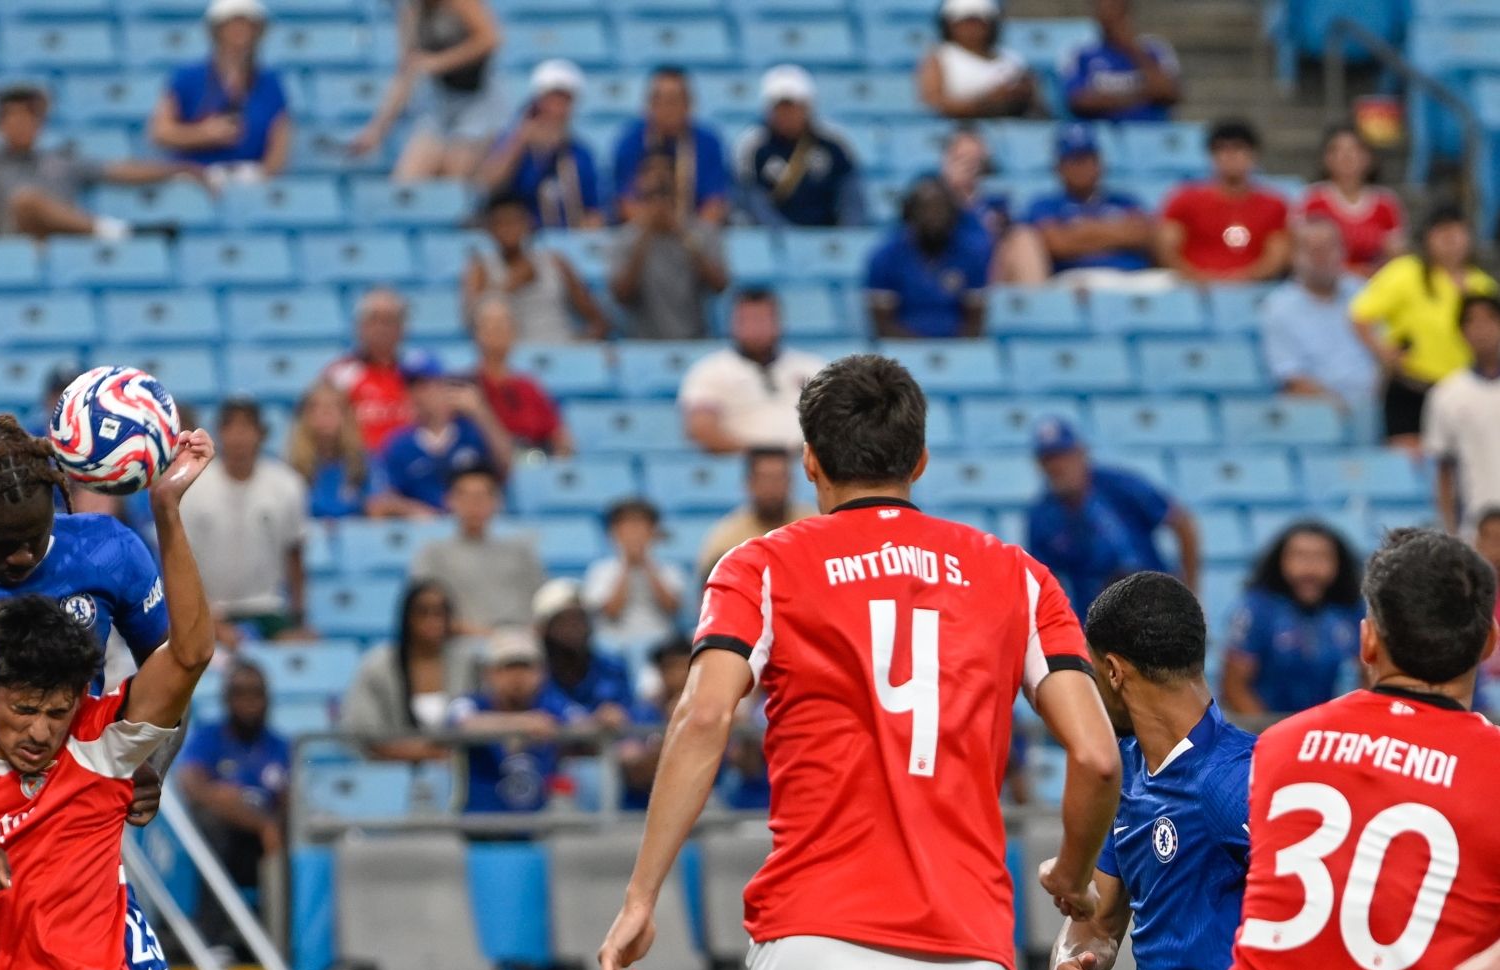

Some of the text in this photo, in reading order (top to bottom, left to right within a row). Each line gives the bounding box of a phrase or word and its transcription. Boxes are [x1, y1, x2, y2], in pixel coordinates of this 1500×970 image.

[824, 541, 970, 586] ANTÓNIO S.
[868, 599, 940, 777] 4
[1297, 729, 1458, 788] OTAMENDI
